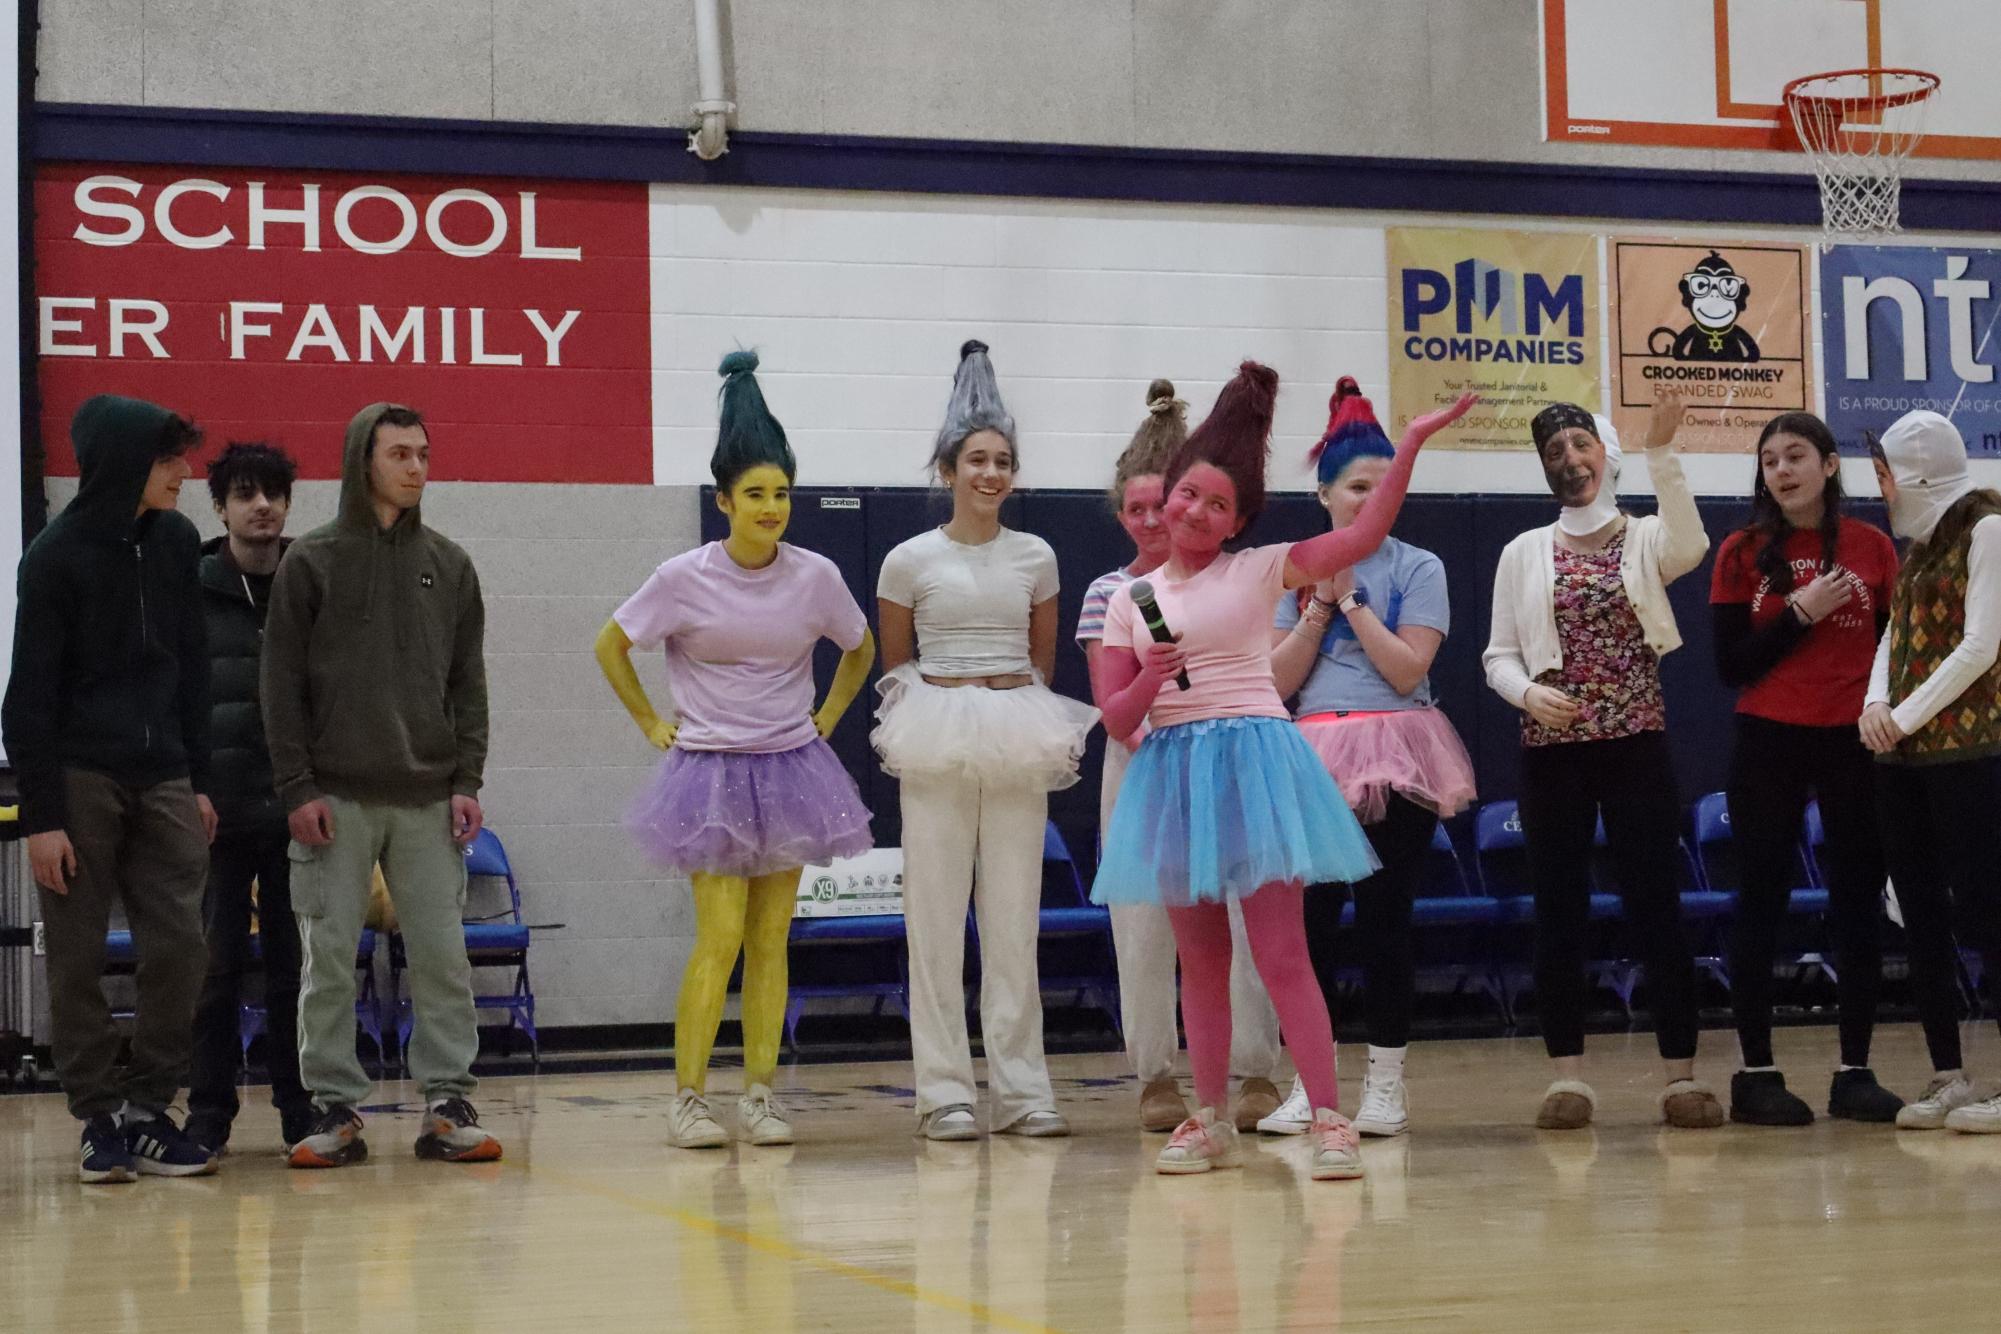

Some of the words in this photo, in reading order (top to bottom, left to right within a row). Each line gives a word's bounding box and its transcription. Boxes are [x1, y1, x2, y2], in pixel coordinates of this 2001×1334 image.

[73, 175, 582, 260] SCHOOL
[1402, 258, 1584, 337] PMM
[39, 296, 170, 358] ER
[229, 301, 581, 366] FAMILY
[1405, 336, 1584, 364] COMPANIES
[1642, 366, 1716, 380] CROOKED
[1719, 368, 1784, 382] MONKEY
[1443, 379, 1462, 390] Your
[1465, 379, 1497, 391] Trusted
[1500, 380, 1537, 391] Janitorial
[1540, 381, 1547, 391] &
[1731, 386, 1774, 399] SWAG
[1476, 397, 1524, 407] anagement
[1840, 397, 1849, 410] IS
[1853, 398, 1862, 410] A
[1865, 398, 1908, 411] PROUD
[1913, 398, 1971, 412] SPONSOR
[1974, 399, 1991, 413] OF
[1468, 416, 1527, 431] SPONSOR
[1685, 414, 1721, 427] Owned
[1723, 417, 1731, 427] &
[1733, 415, 1768, 430] Operat
[817, 880, 834, 900] X9
